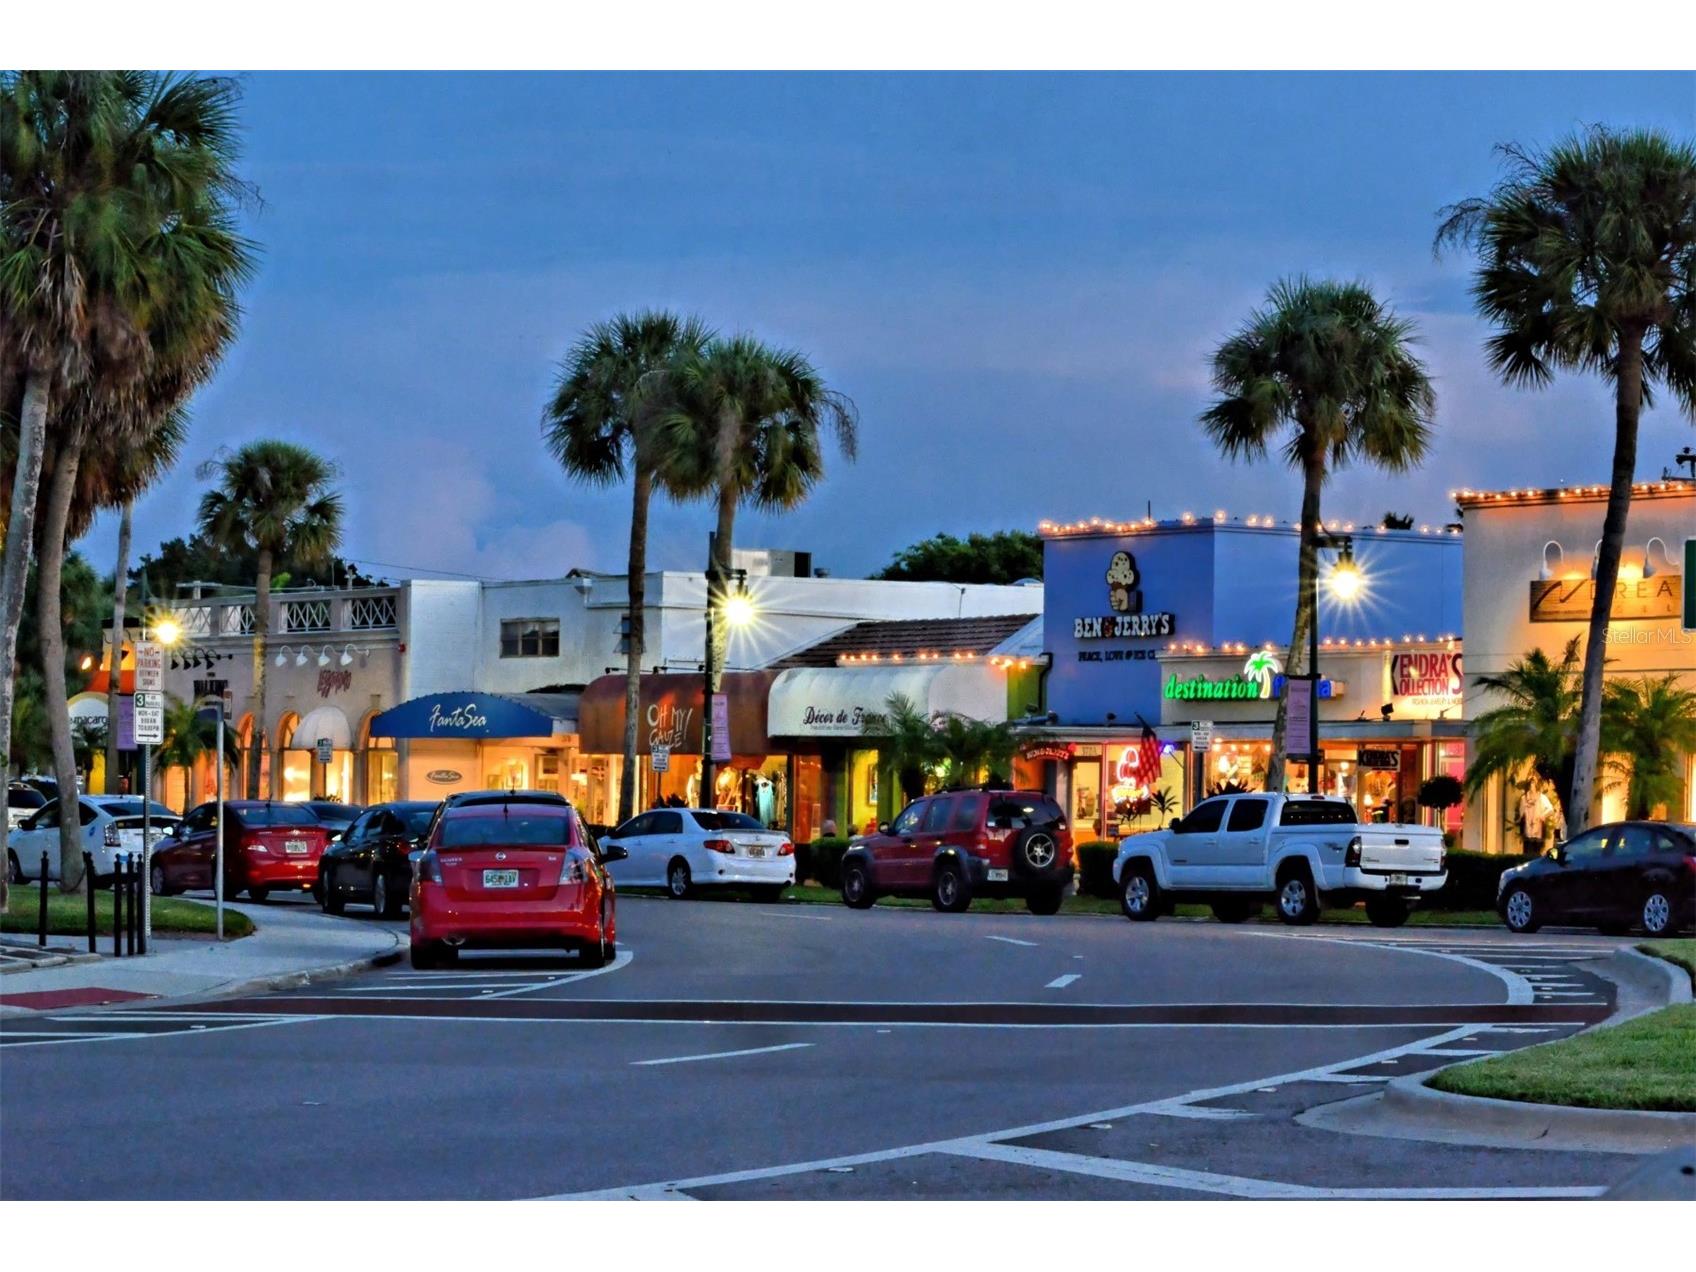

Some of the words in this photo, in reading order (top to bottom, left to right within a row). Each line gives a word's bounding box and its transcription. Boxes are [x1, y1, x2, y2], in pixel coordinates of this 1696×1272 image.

[1073, 616, 1103, 638] BEN
[1114, 612, 1170, 637] JERRY'S
[144, 647, 155, 657] NO
[138, 658, 160, 668] PARKING
[1164, 673, 1259, 699] destination
[136, 694, 144, 706] 3
[647, 703, 668, 727] OH
[803, 705, 833, 725] Décor
[836, 709, 848, 723] de
